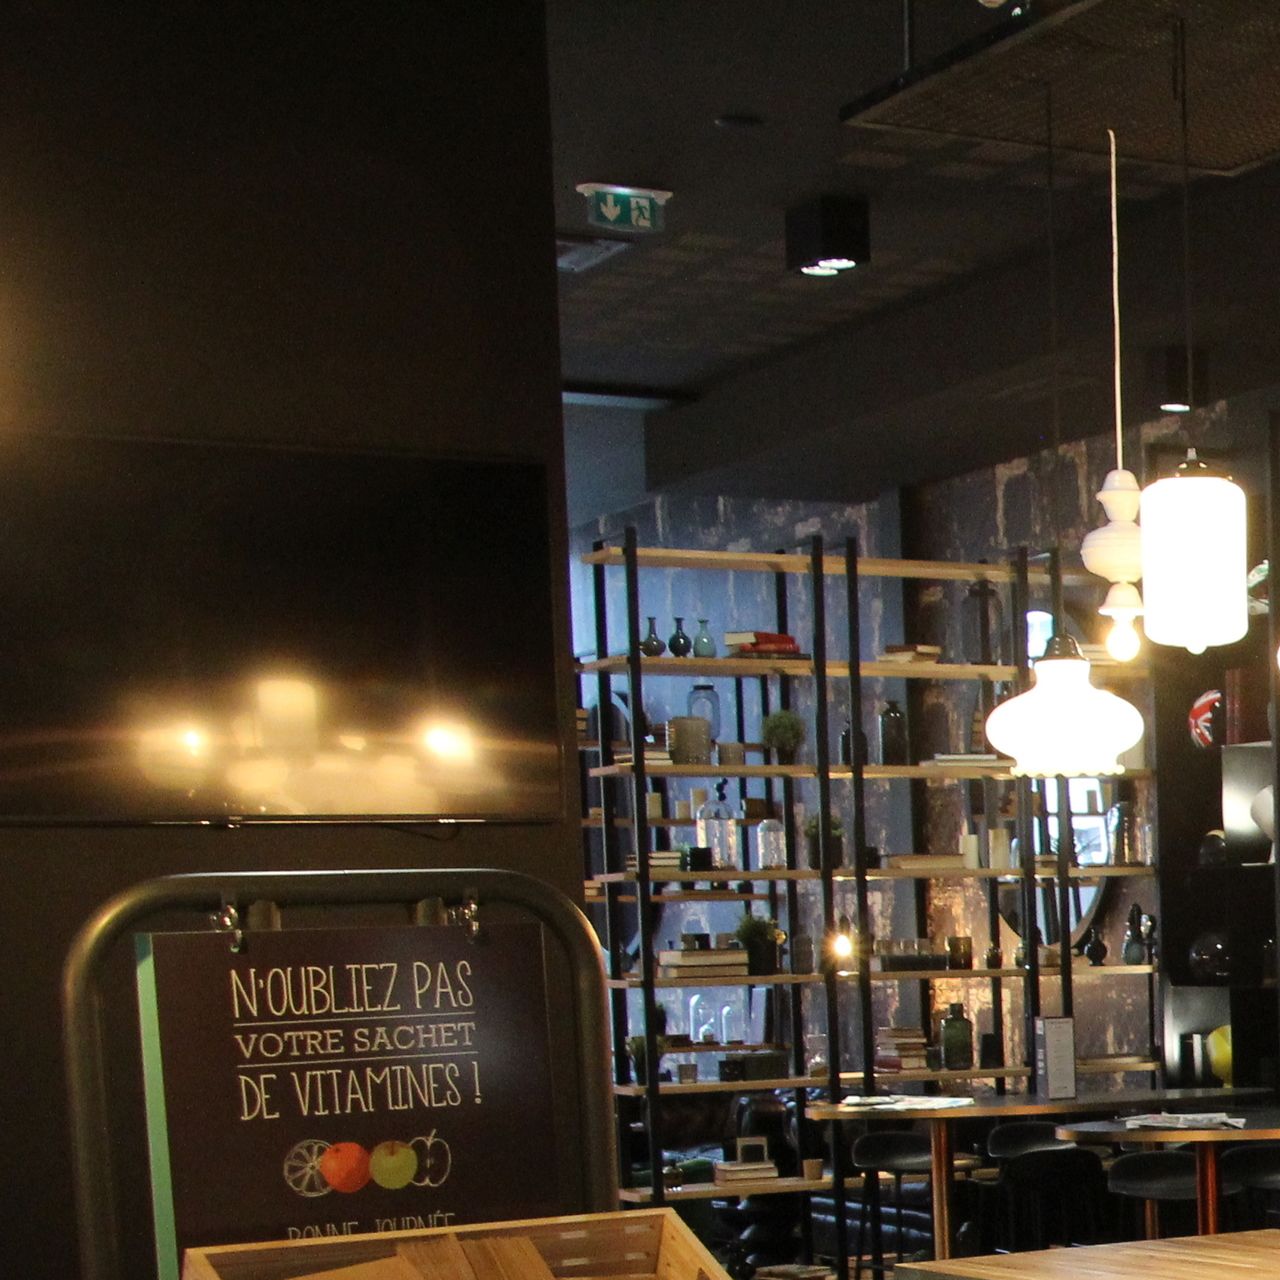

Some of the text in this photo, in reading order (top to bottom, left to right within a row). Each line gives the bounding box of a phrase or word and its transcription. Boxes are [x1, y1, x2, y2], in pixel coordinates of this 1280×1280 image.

[230, 960, 473, 1018] N'OUBLIEZ PAS
[234, 1022, 476, 1059] VOTRE SACHET
[239, 1074, 280, 1121] DE
[291, 1062, 461, 1116] VITAMINES
